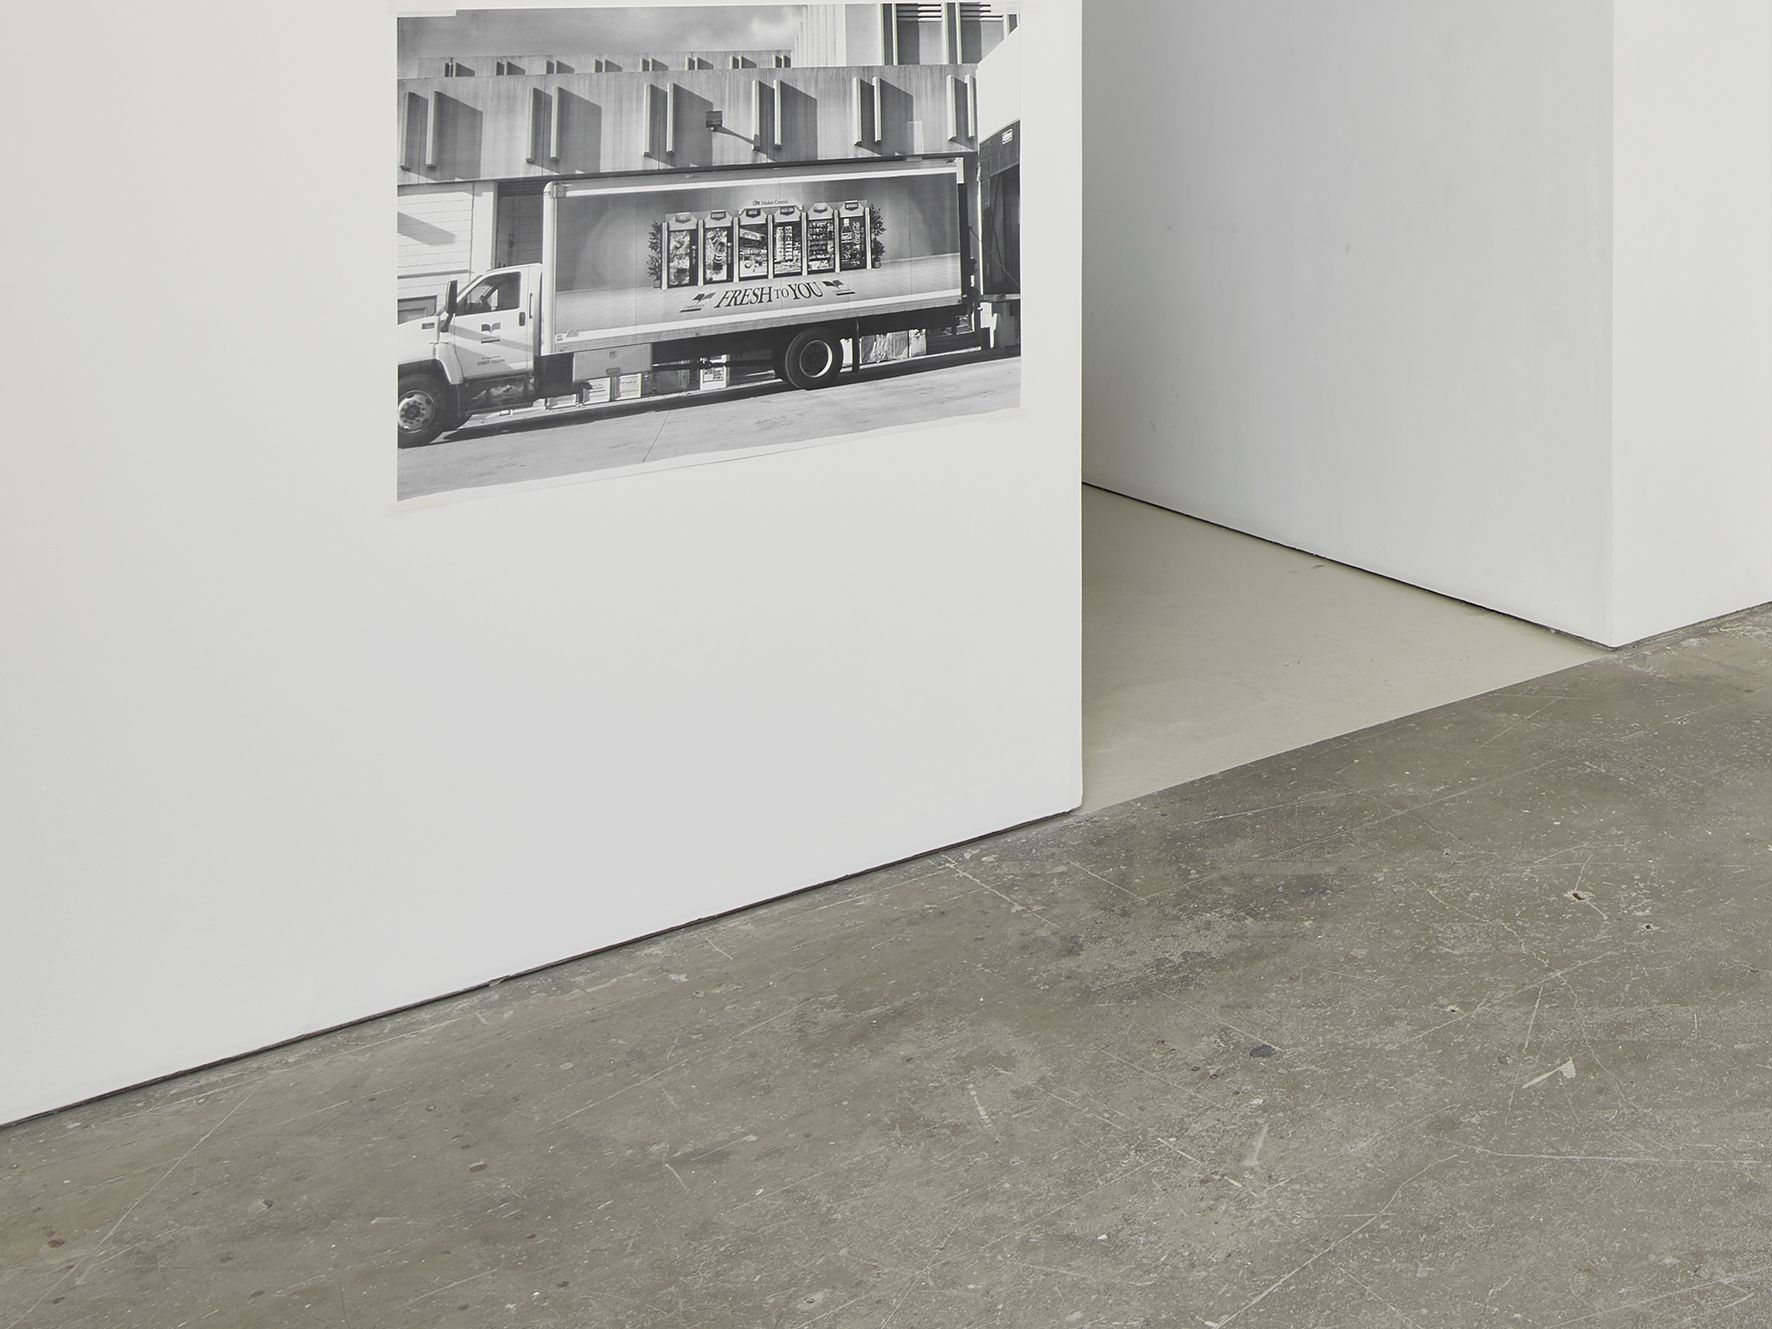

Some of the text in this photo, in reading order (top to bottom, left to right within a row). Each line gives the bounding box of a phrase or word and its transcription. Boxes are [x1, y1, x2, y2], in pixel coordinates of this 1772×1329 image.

[713, 281, 823, 309] FRESH TO YOU
